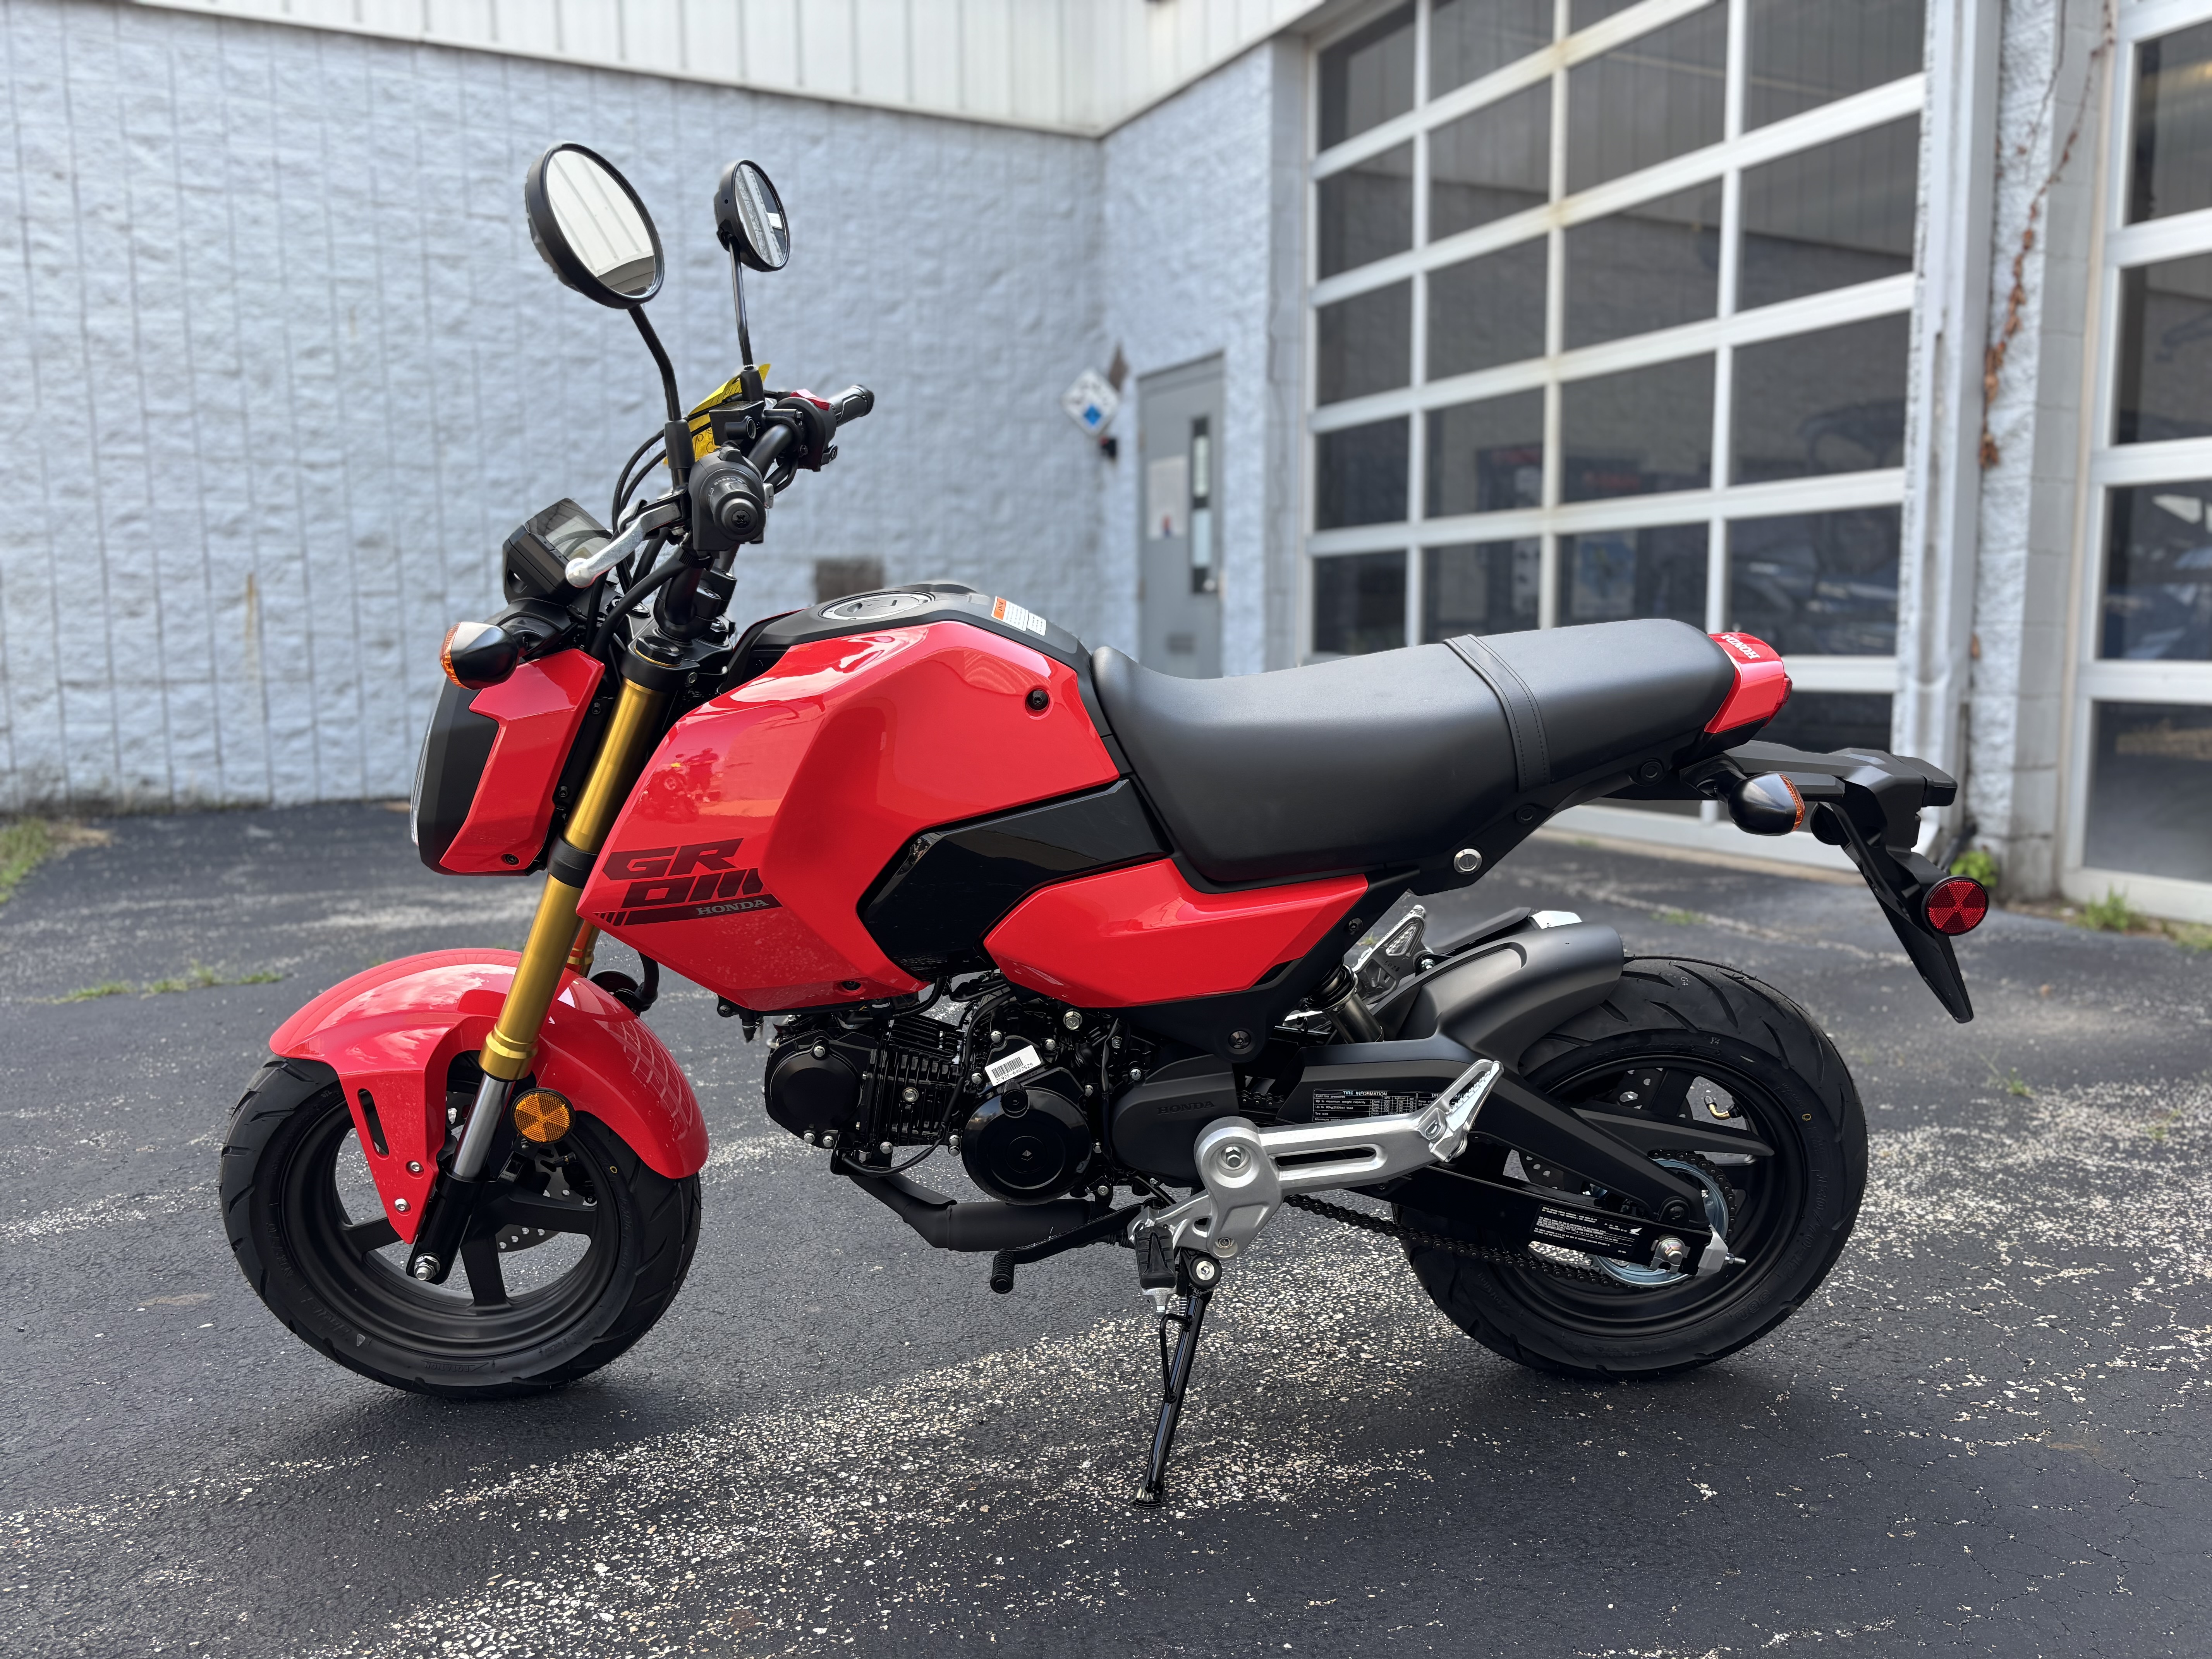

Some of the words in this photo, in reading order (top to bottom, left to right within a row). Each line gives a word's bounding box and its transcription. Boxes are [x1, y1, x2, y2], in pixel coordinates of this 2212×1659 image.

[1721, 634, 1760, 659] HONDA
[603, 838, 744, 880] GR
[696, 899, 769, 915] HONDA
[996, 1062, 1033, 1083] JC92E-6402529
[1156, 1101, 1216, 1115] HONDA
[1735, 1289, 1772, 1321] 56L
[424, 1361, 470, 1372] ROTATION
